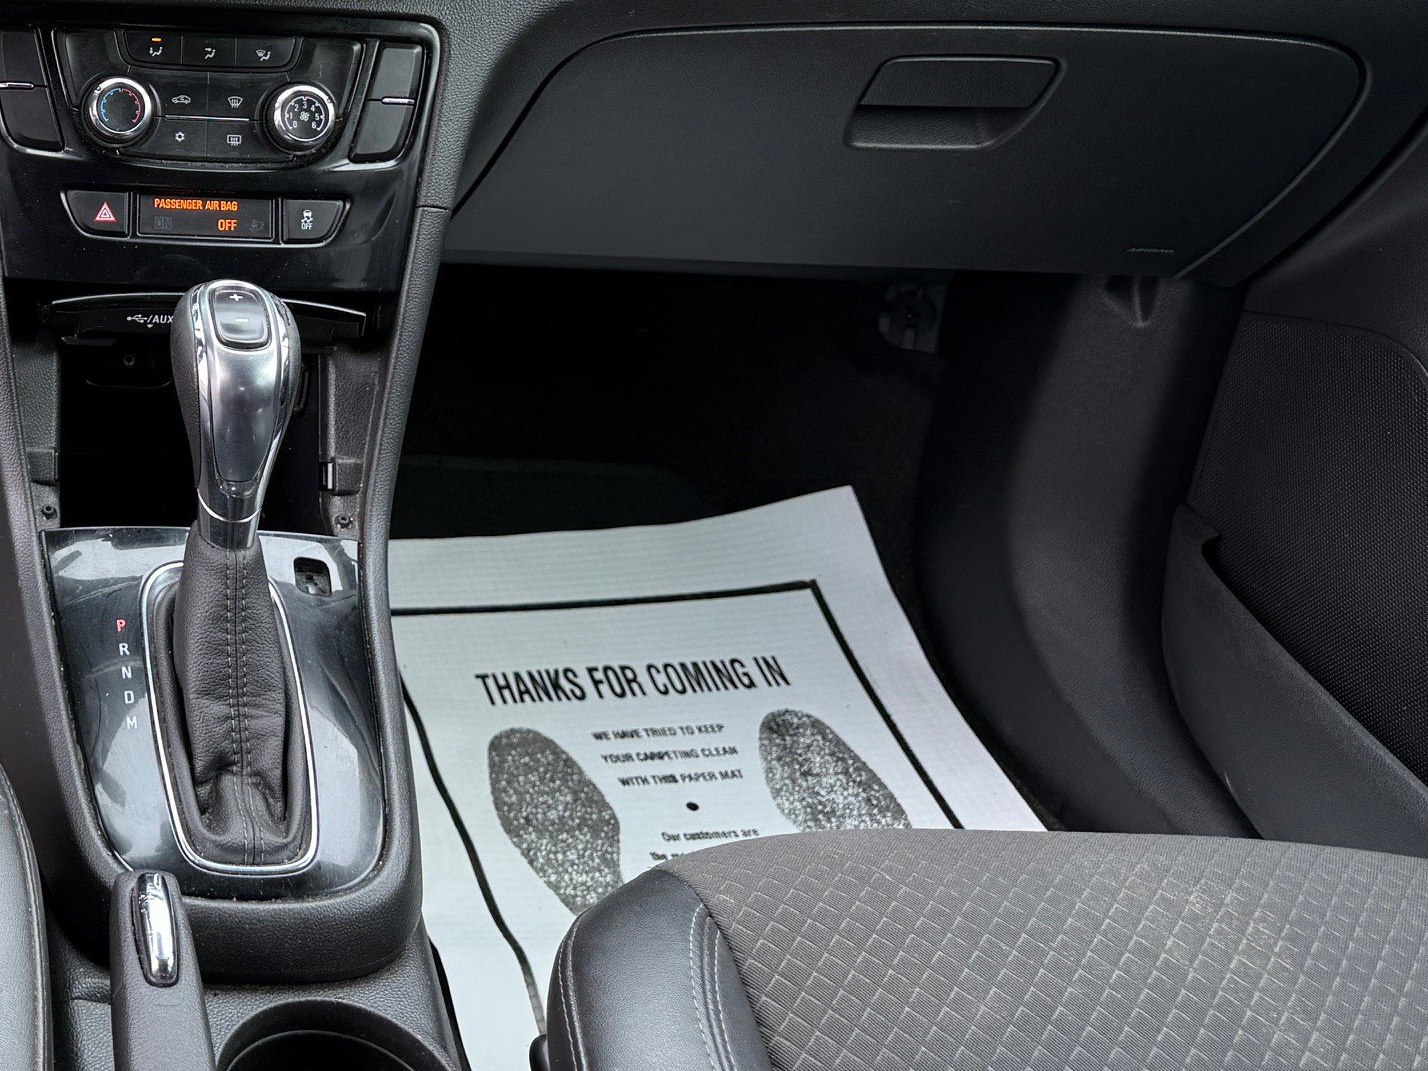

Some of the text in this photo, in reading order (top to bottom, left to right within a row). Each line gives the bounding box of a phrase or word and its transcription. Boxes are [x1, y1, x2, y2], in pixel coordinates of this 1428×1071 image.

[315, 113, 320, 121] 5
[292, 120, 298, 128] 0
[154, 198, 238, 211] PASSENGER AIR BAG
[217, 219, 237, 231] OFF
[116, 619, 127, 632] P
[119, 643, 130, 656] R
[121, 666, 132, 679] N
[474, 655, 791, 706] THANKS FOR COMING IN
[124, 690, 134, 704] D
[126, 715, 138, 729] M
[591, 722, 724, 741] WE HAVE TRIED TO KEEP
[601, 745, 738, 764] YOUR CARPETING CLEAN
[618, 775, 651, 787] WITH
[680, 771, 718, 784] PAPER
[718, 768, 744, 780] MAT
[662, 828, 759, 842] Our customers are
